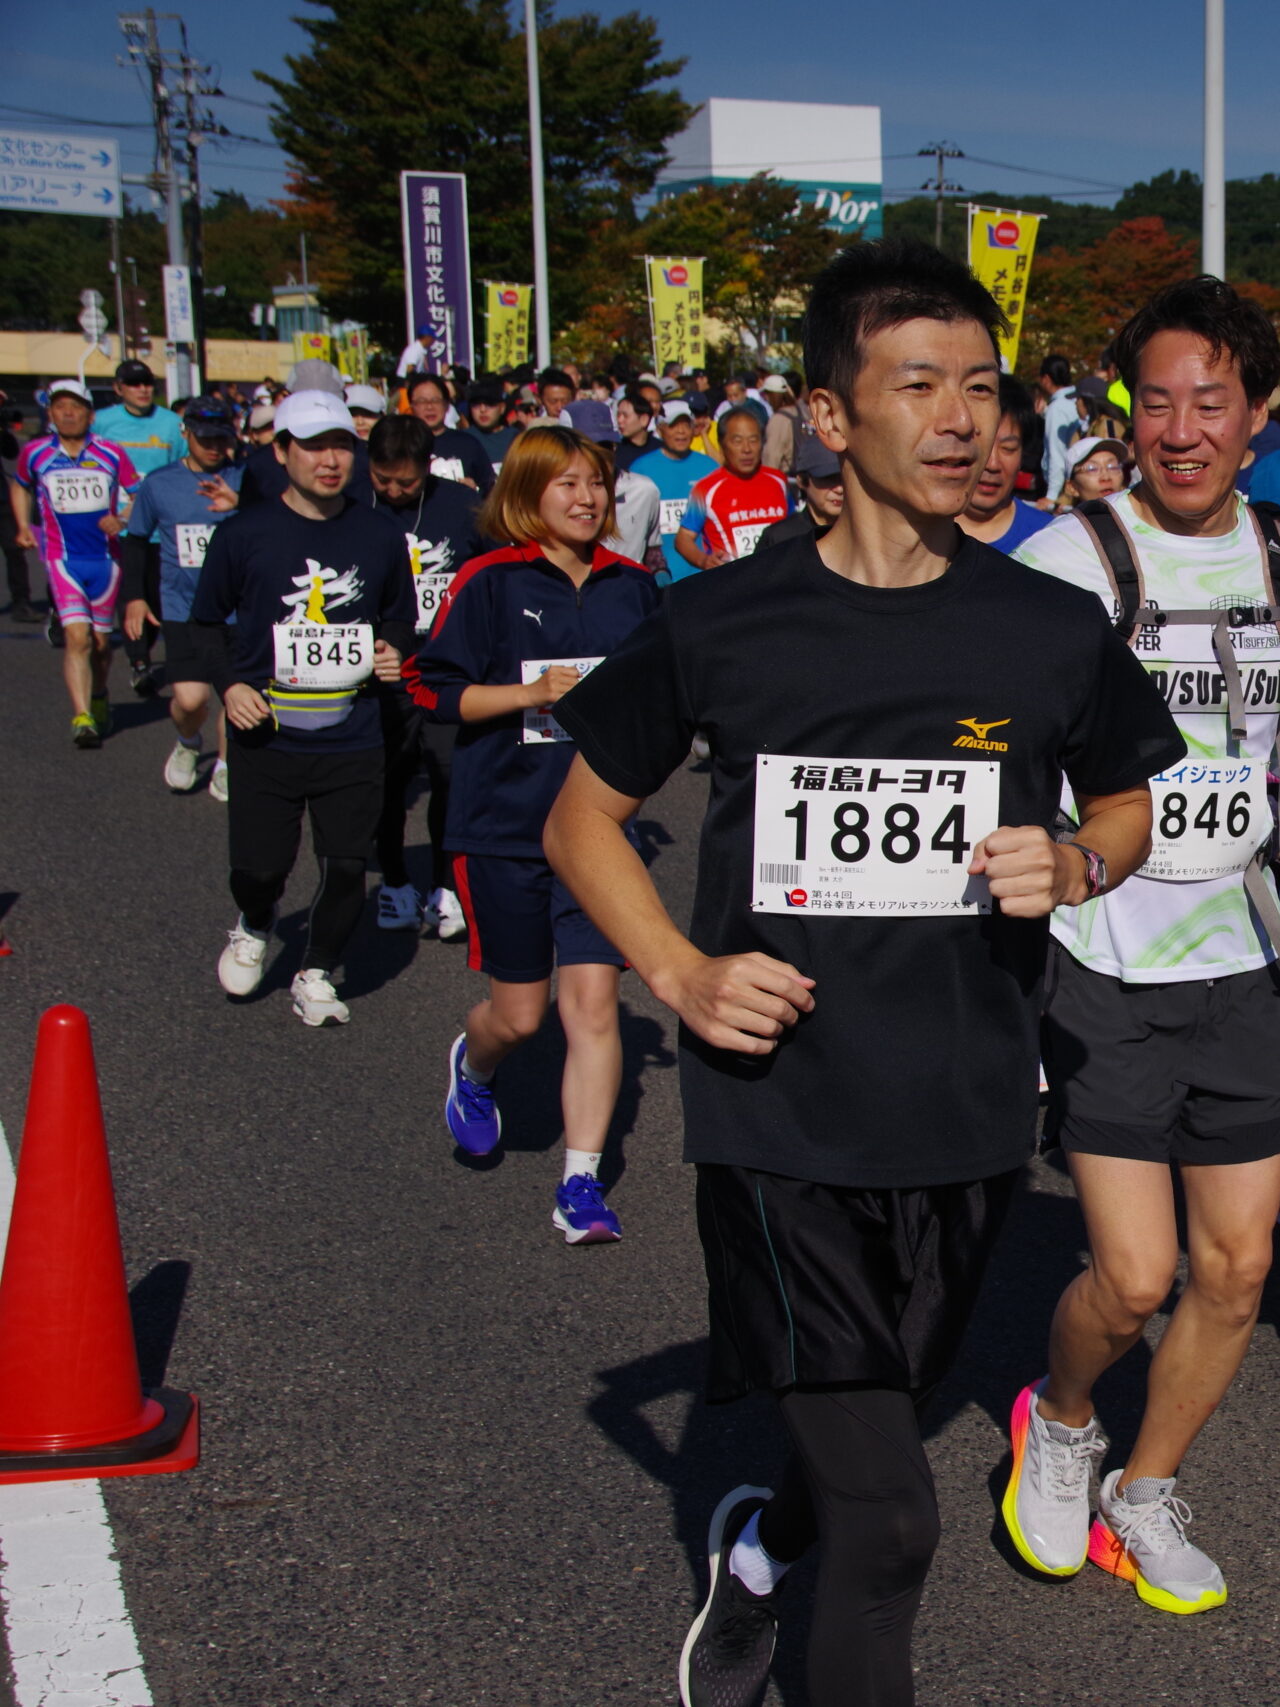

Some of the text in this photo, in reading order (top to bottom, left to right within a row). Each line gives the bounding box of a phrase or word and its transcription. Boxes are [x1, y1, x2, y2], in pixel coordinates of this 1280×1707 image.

[57, 484, 103, 500] 2010
[666, 509, 683, 522] 19
[185, 536, 207, 552] 19
[417, 577, 448, 586] トヨタ
[289, 628, 359, 638] 福島トヨタ
[288, 642, 362, 666] 1845
[789, 764, 967, 794] 福島トヨタ
[1159, 791, 1251, 840] 846
[784, 800, 971, 864] 1884
[811, 890, 853, 900] 第44回
[811, 900, 971, 910] 円谷幸吉メモリアルマラソン大会
